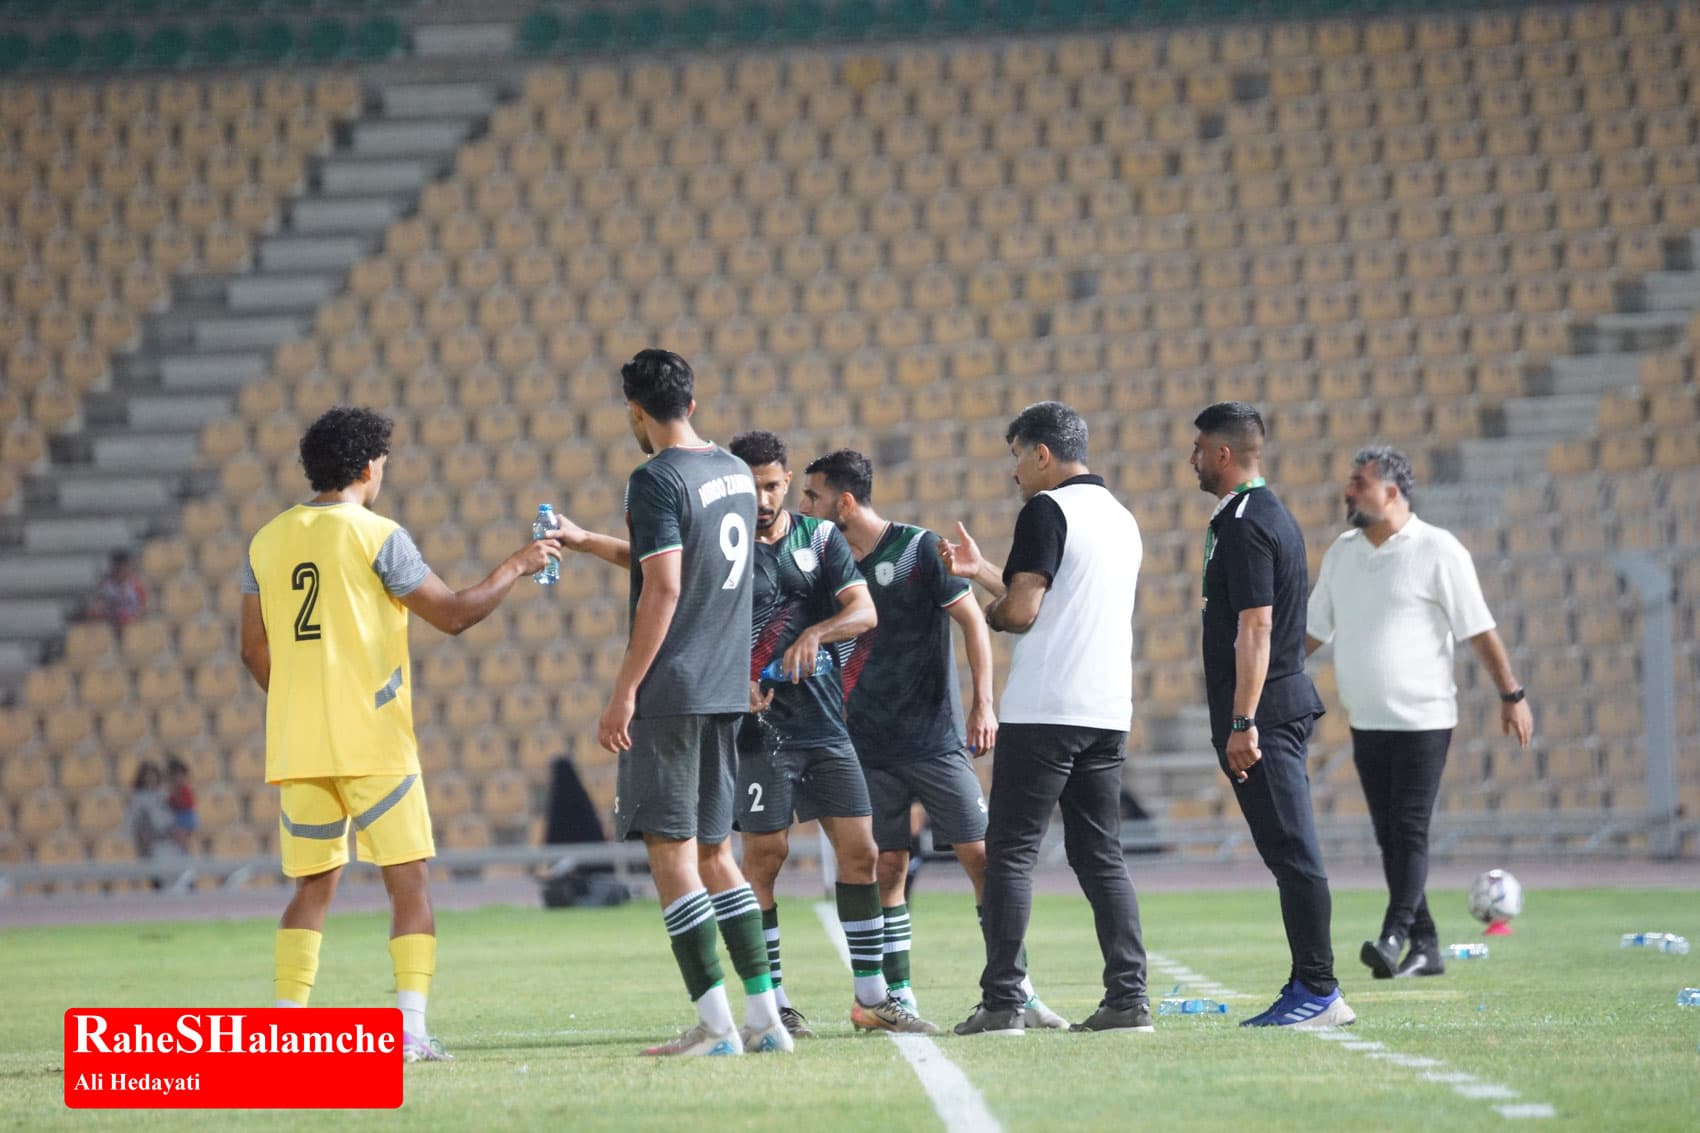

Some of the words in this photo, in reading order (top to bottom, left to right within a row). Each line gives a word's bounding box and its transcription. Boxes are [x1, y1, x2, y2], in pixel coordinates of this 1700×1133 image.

[719, 512, 748, 590] 9
[292, 561, 322, 642] 2
[748, 782, 765, 812] 2
